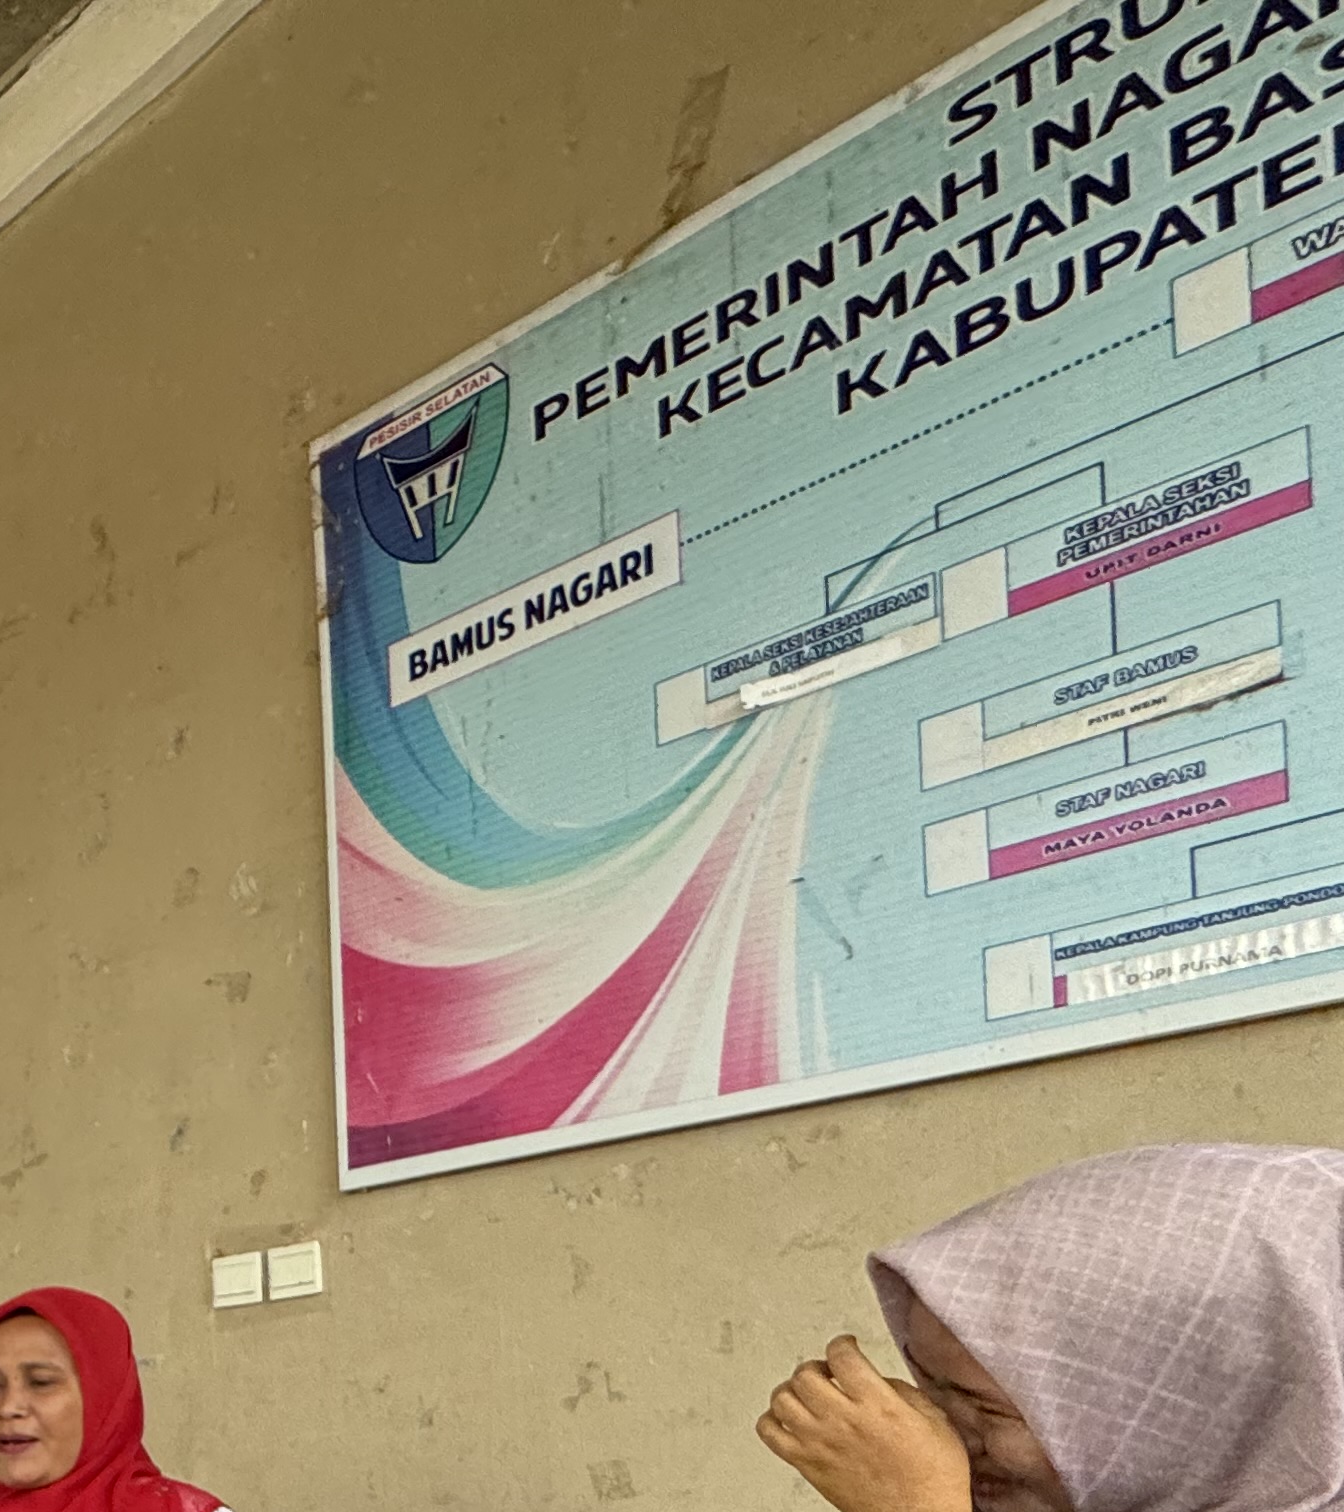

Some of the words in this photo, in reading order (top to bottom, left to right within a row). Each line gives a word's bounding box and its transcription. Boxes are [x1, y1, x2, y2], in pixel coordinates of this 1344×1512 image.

[947, 0, 1211, 147] STRU
[533, 149, 999, 442] PEMERINTAH
[658, 152, 1131, 440] KECAMATAN
[836, 121, 1344, 416] KABUPATE
[368, 411, 424, 449] PESISIR
[424, 370, 491, 417] SELATAN
[1056, 477, 1252, 567] PEMERINTAHAN
[1064, 493, 1161, 545] KEPALA
[1161, 461, 1241, 505] SEKSI
[408, 607, 516, 682] BAMUS
[523, 542, 654, 630] NAGARI
[711, 649, 763, 682] KEPALA
[762, 632, 804, 661] SEKSI
[803, 582, 930, 646] KESEJAHTERAAN
[780, 626, 864, 672] PELAYANAN
[1053, 673, 1111, 706] STAF
[1113, 645, 1199, 687] BAMUS
[1043, 830, 1107, 855] MAYA
[1114, 797, 1229, 836] YOLANDA
[1054, 787, 1112, 818] STAF
[1114, 760, 1207, 800] NAGARI
[1054, 937, 1114, 961] KEPALA
[1113, 917, 1201, 949] KAMPUNG
[1200, 898, 1281, 931] TANJUNG
[1125, 967, 1173, 986] DOPI
